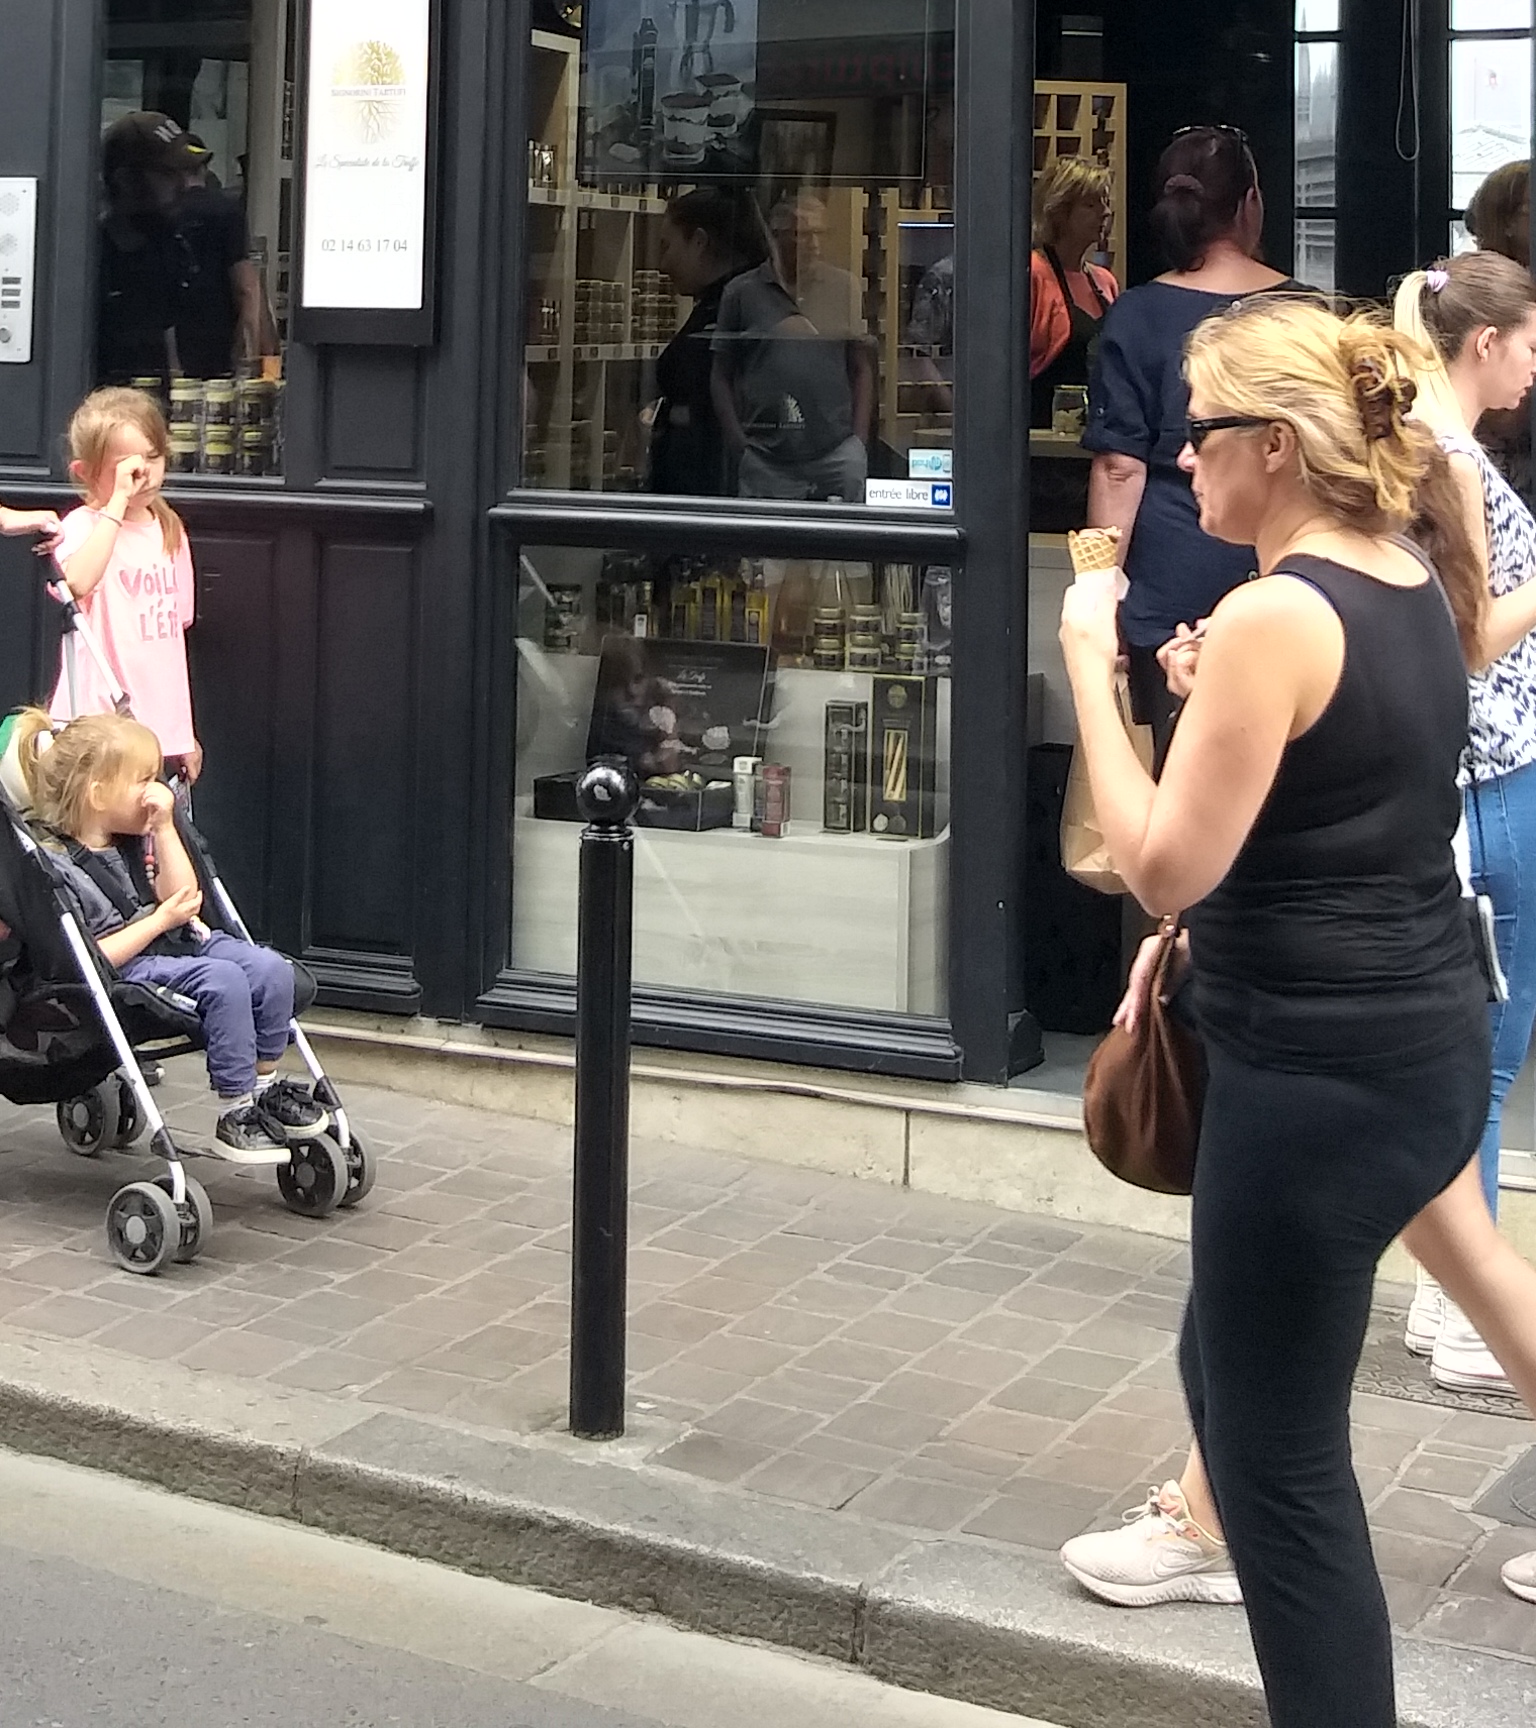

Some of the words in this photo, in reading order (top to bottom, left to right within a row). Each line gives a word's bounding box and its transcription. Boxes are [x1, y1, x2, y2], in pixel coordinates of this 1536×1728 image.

[321, 239, 336, 252] 02
[340, 239, 354, 252] 14
[357, 239, 372, 252] 63
[376, 239, 390, 252] 17
[393, 239, 408, 252] 04
[868, 487, 903, 500] entrée
[905, 487, 929, 501] libre
